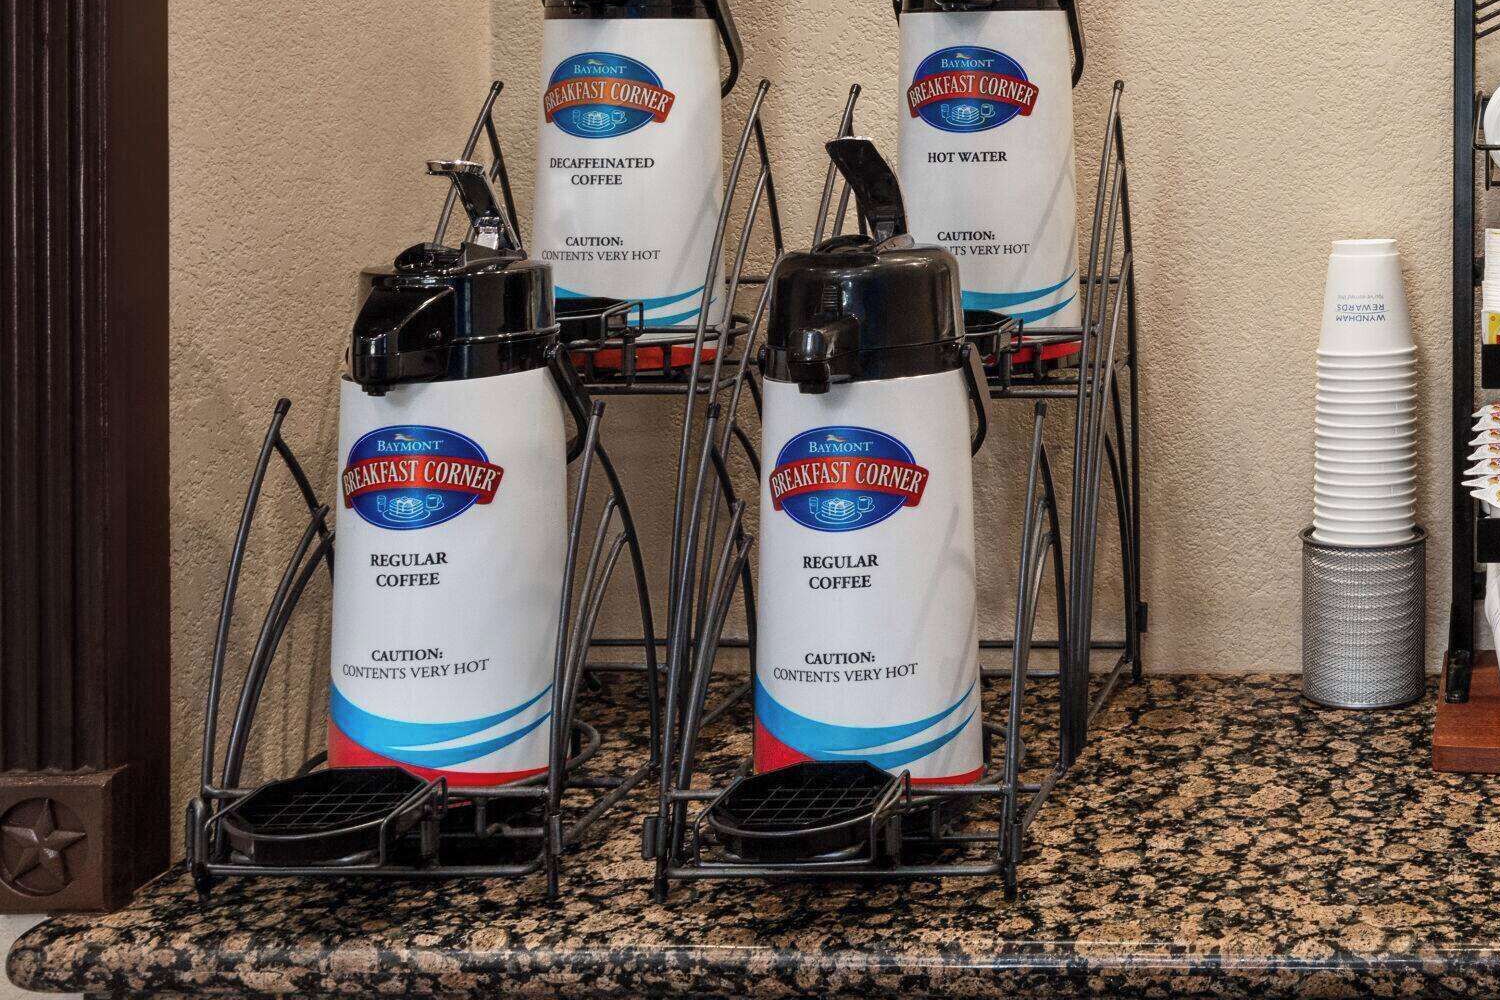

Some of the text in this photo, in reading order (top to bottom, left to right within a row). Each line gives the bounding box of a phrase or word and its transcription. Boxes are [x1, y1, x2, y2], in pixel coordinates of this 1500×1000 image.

[574, 64, 624, 74] BAYMONT
[941, 59, 992, 68] BAYMONT
[544, 81, 670, 112] BREAKFAST CORNER
[909, 75, 1034, 107] BREAKFAST CORNER
[549, 157, 655, 169] DECAFFEINATED
[927, 151, 1007, 163] HOT WATER
[571, 174, 623, 185] COFFEE
[565, 236, 624, 247] CAUTION:
[937, 231, 995, 241] CAUTION:
[541, 249, 661, 261] CONTENTS VERY HOT
[970, 245, 1000, 255] VERY
[1003, 243, 1030, 254] HOT
[1336, 303, 1385, 312] REWARDS
[1336, 314, 1385, 322] WYNDHAM
[377, 440, 440, 452] BAYMONT
[809, 441, 871, 453] BAYMONT
[343, 460, 497, 496] BREAKFAST CORNER
[771, 461, 924, 498] BREAKFAST CORNER
[370, 551, 448, 567] REGULAR
[802, 553, 879, 569] REGULAR
[376, 573, 440, 587] COFFEE
[808, 575, 871, 590] COFFEE
[371, 648, 443, 661] CAUTION:
[804, 651, 876, 665] CAUTION:
[342, 658, 490, 680] CONTENTS VERY HOT
[773, 662, 918, 683] CONTENTS VERY HOT
